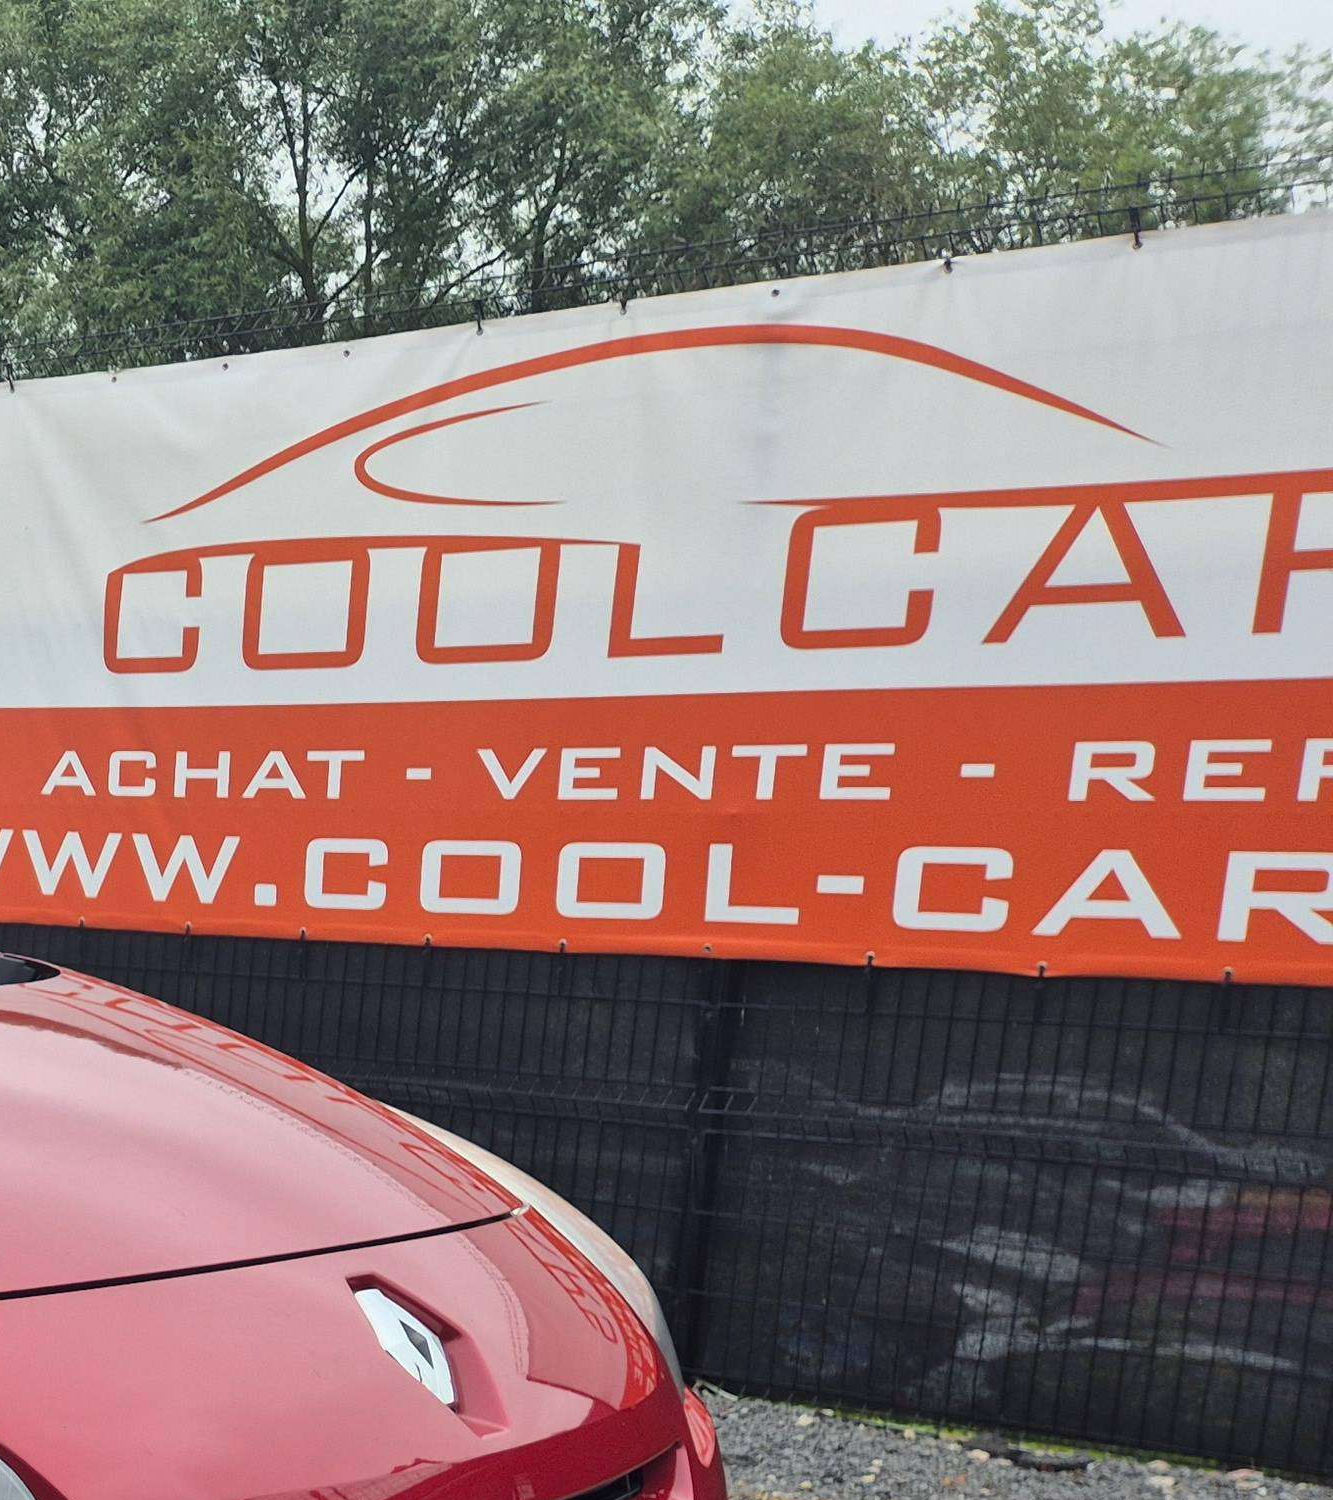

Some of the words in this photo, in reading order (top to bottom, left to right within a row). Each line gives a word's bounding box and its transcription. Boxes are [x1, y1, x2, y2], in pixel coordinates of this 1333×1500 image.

[103, 535, 725, 674] COOL
[40, 749, 366, 800] ACHAT
[405, 767, 433, 780] -
[476, 742, 897, 801] VENTE
[959, 762, 997, 779] -
